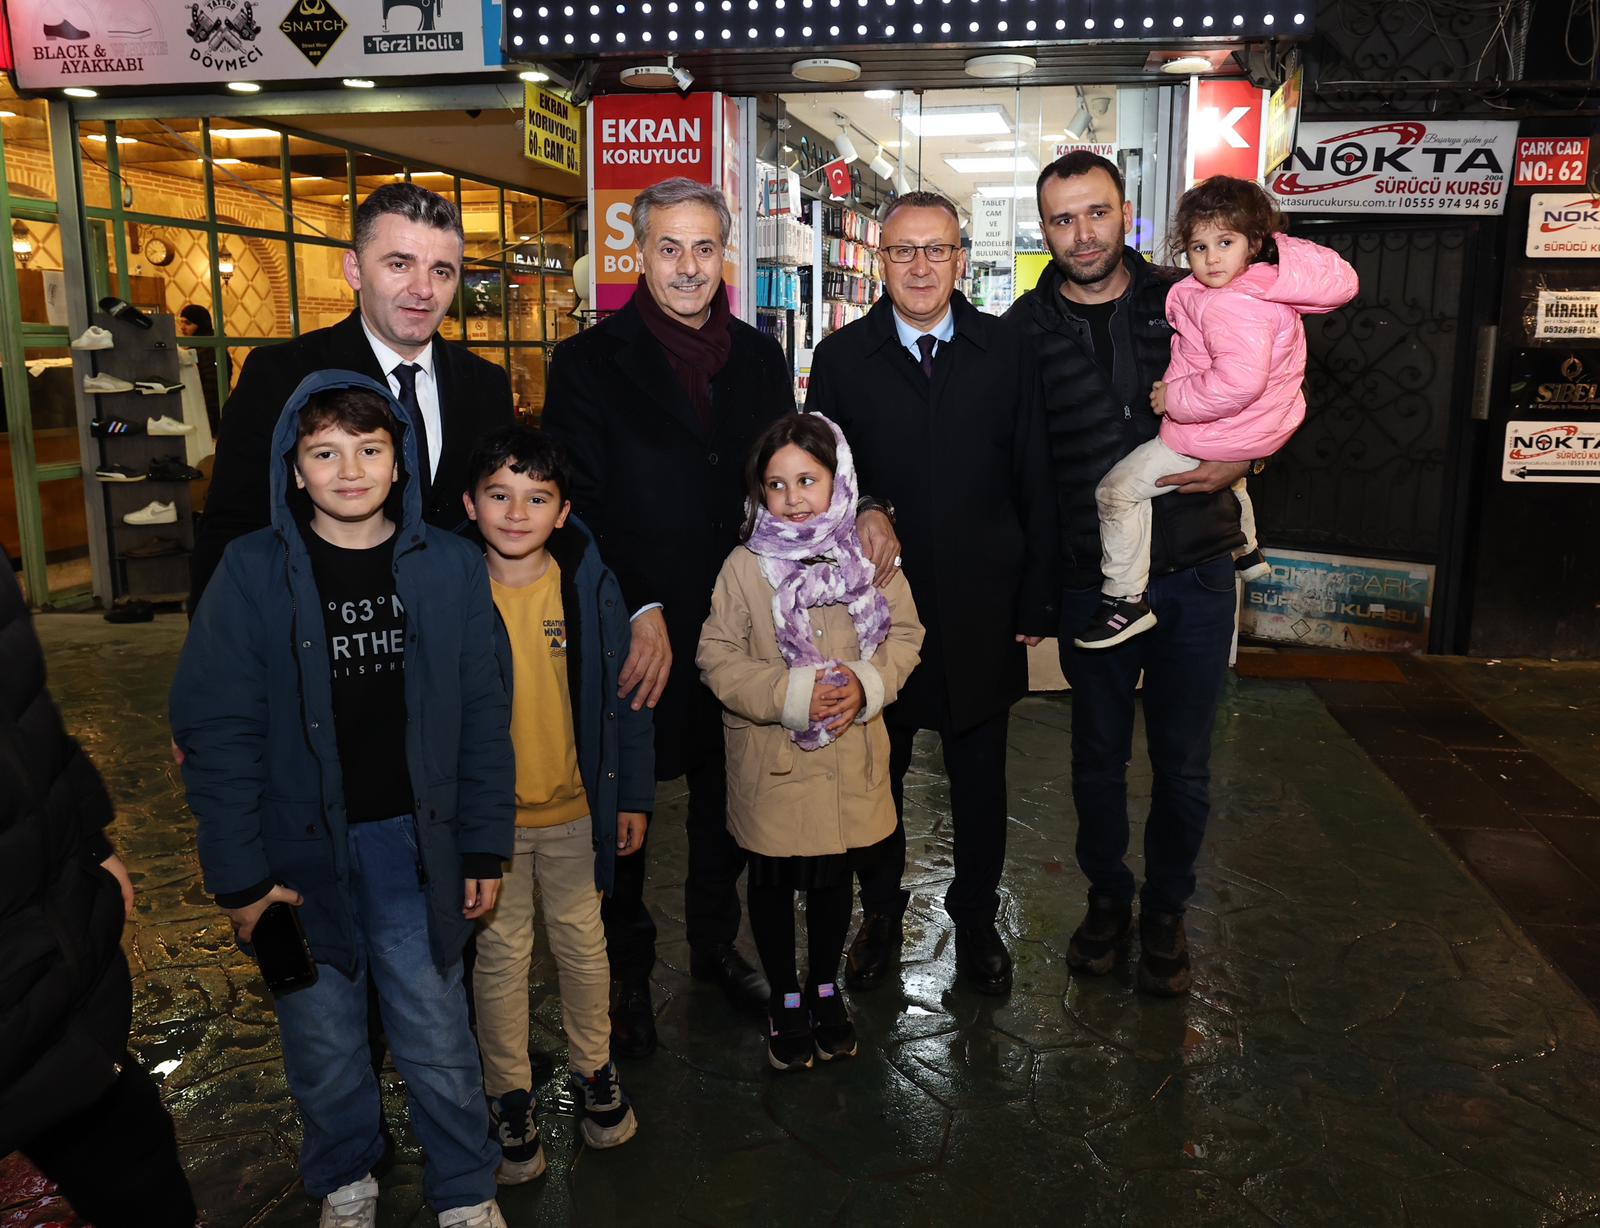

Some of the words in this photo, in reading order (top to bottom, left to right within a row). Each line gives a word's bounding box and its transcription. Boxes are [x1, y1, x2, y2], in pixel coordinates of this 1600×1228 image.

[281, 20, 344, 33] SNATCH
[32, 45, 90, 60] BLACK
[93, 44, 107, 58] &
[372, 35, 411, 53] Terzi
[415, 34, 455, 51] Halil
[60, 58, 144, 74] AYAKKABI
[190, 45, 264, 72] DÖVMECİ
[540, 93, 568, 120] EKRAN
[529, 109, 577, 144] KORUYUCU
[602, 118, 701, 143] EKRAN
[544, 138, 565, 164] CAM
[602, 149, 701, 165] KORUYUCU
[1521, 142, 1554, 158] ÇARK
[1556, 141, 1585, 156] CAD.
[1281, 142, 1504, 177] NOKTA
[1519, 161, 1554, 181] NO:
[1558, 160, 1583, 181] 62
[1374, 176, 1442, 195] SÜRÜCÜ
[1445, 181, 1503, 196] KURSU
[1280, 197, 1396, 208] ktasurucukursu.com.tr
[1404, 198, 1435, 209] 0555
[1438, 199, 1462, 209] 974
[1464, 199, 1481, 209] 94
[1483, 199, 1499, 210] 96
[1544, 210, 1600, 222] NOK
[1544, 240, 1588, 252] SÜRÜCÜ
[1545, 301, 1598, 318] KİRALIK
[1556, 451, 1587, 460] SÜRÜCÜ
[332, 628, 405, 661] RTHE
